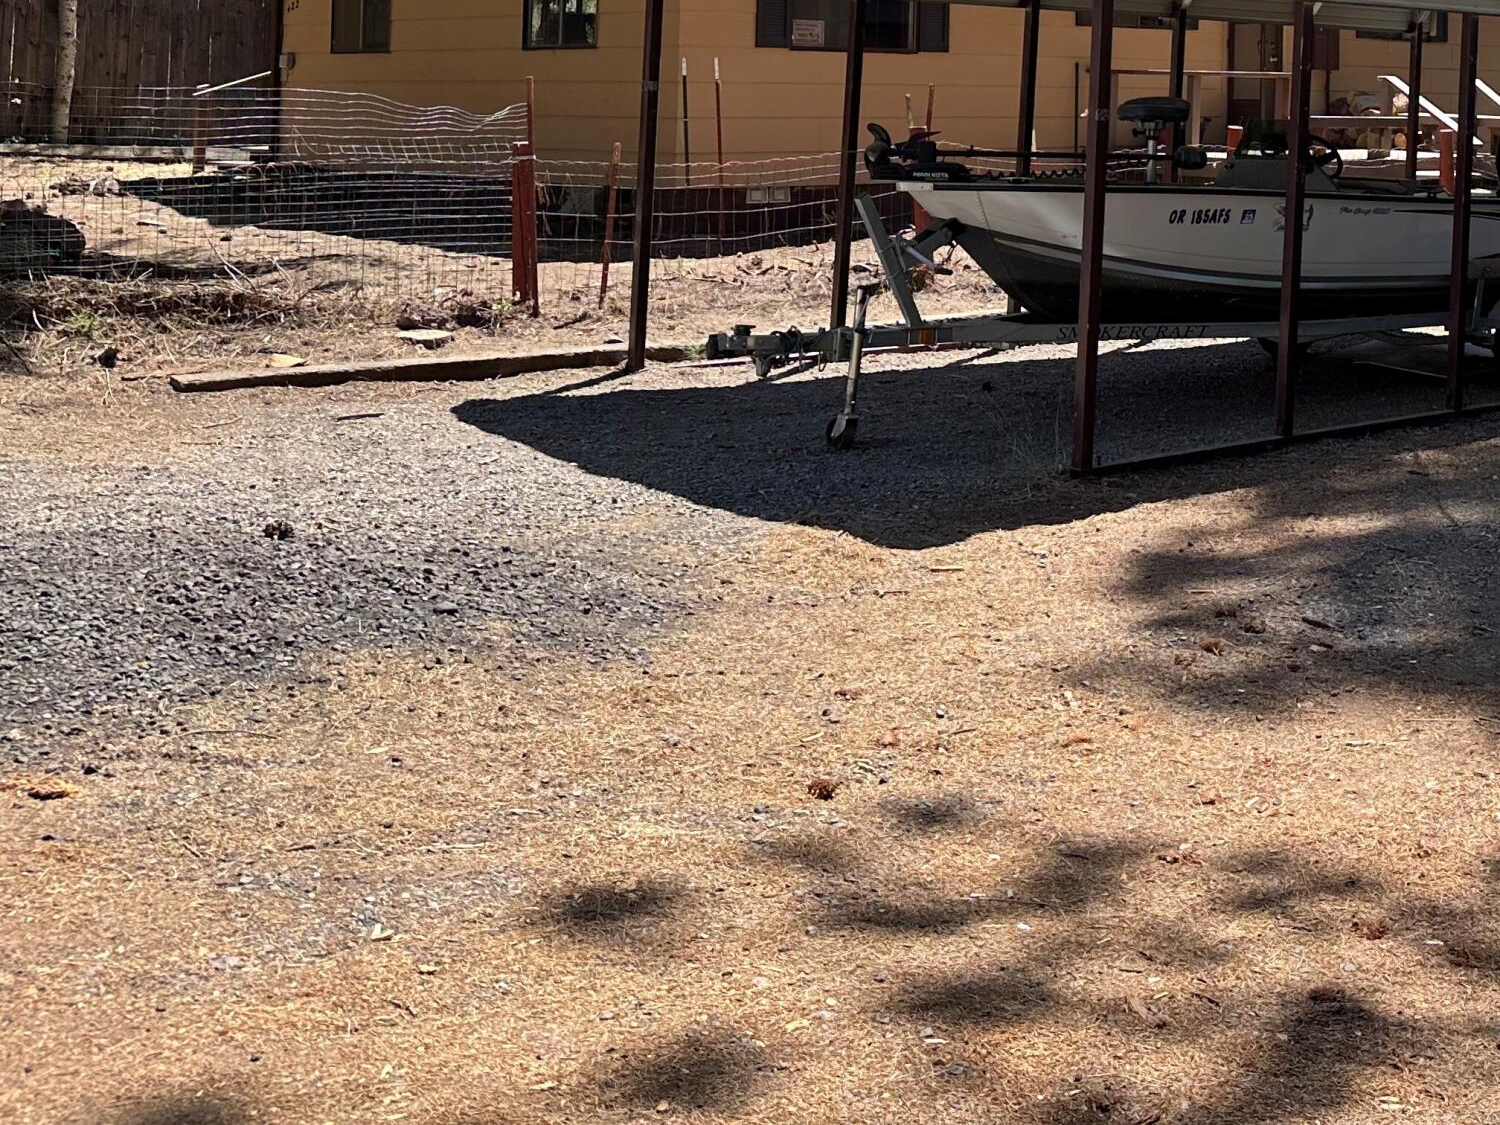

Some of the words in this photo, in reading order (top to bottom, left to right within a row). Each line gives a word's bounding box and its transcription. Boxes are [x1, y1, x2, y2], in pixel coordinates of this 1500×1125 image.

[1169, 209, 1186, 224] OR
[1191, 208, 1231, 225] 185AFS
[1056, 326, 1211, 340] SKERCRAFT
